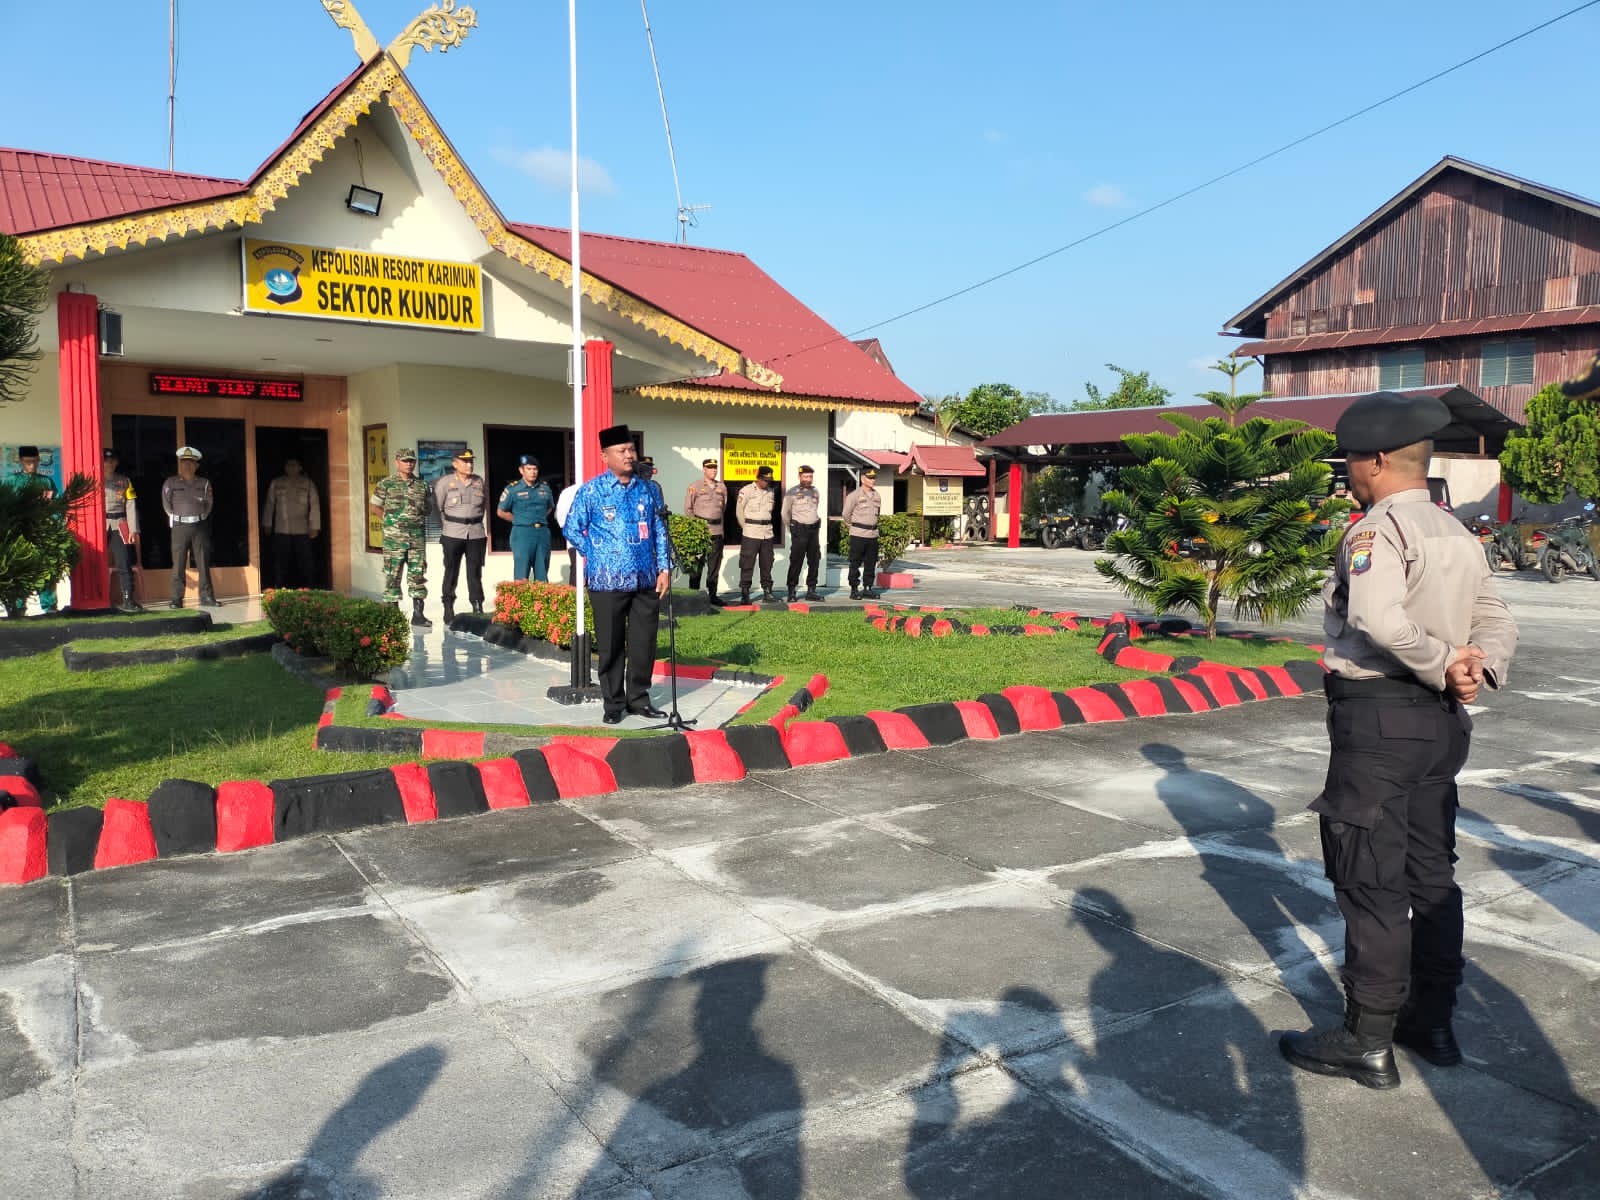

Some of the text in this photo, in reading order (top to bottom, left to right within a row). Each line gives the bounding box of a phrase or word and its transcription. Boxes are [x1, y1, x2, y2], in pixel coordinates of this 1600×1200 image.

[312, 249, 379, 279] KEPOLISIAN
[383, 260, 424, 283] RESORT
[428, 264, 476, 289] KARIMUN
[318, 281, 474, 324] SEKTOR KUNDUR
